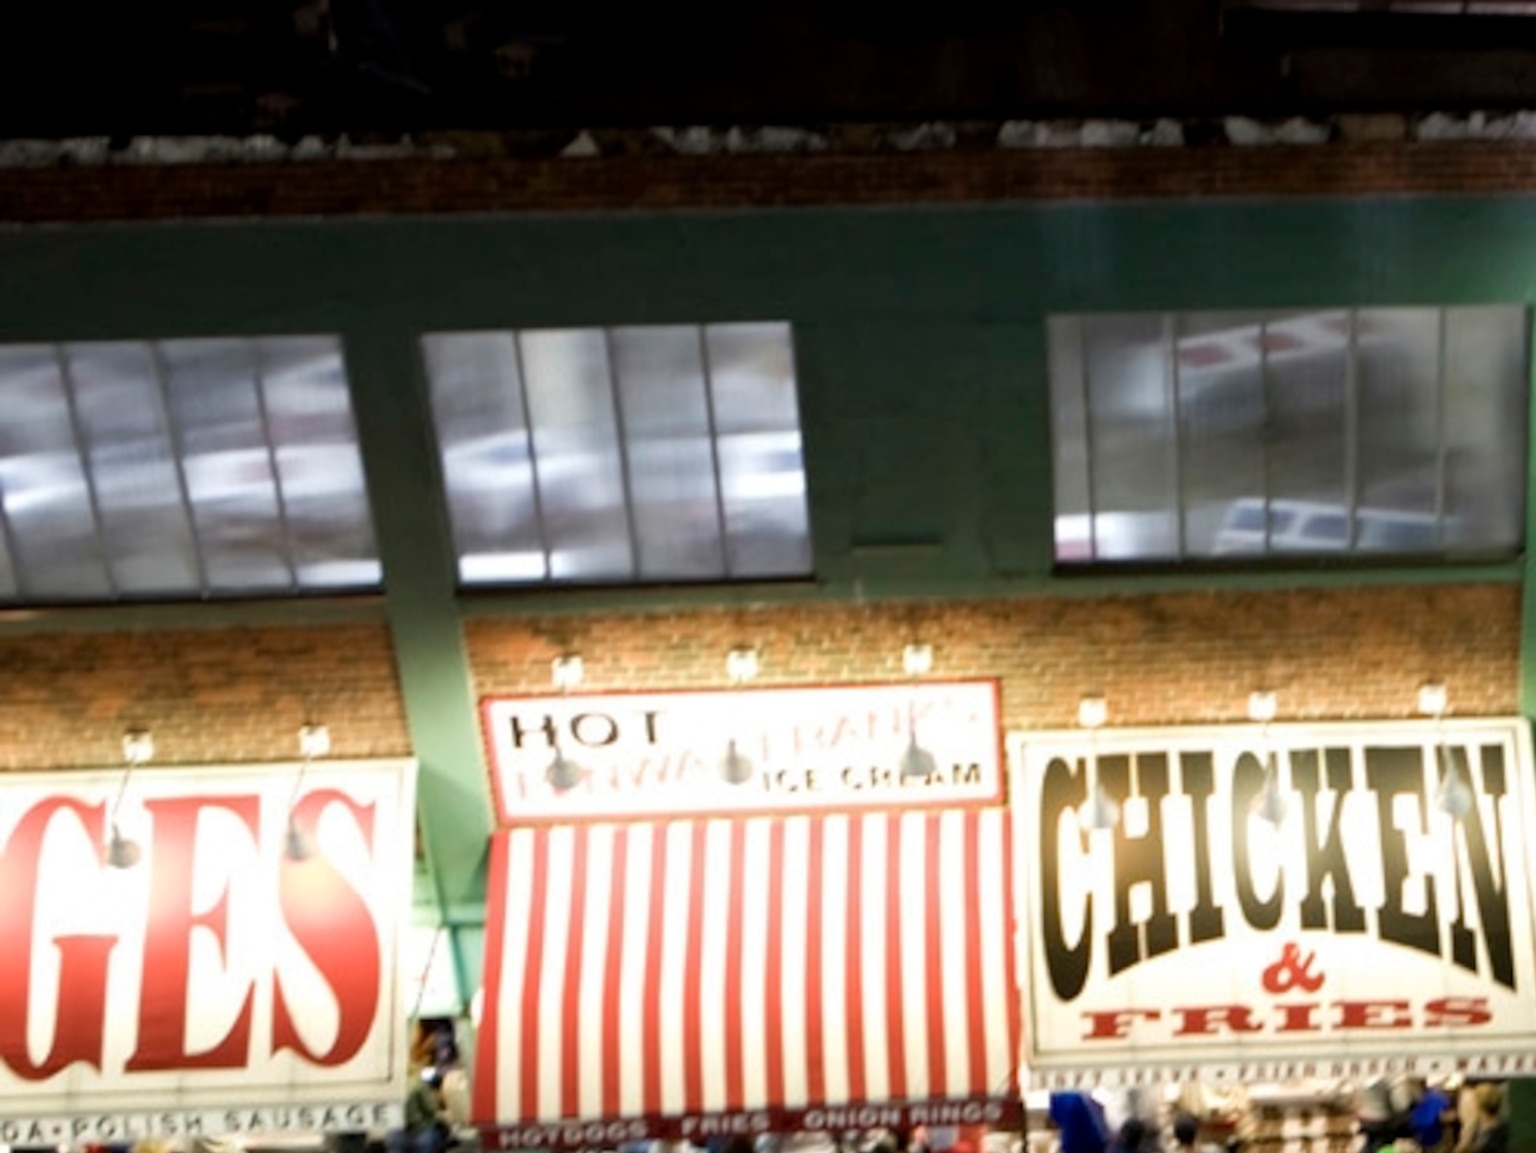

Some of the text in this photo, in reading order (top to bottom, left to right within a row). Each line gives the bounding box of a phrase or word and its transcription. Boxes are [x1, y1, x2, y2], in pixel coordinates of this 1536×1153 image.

[508, 709, 668, 749] HOT
[1039, 744, 1518, 1003] CHICKEN
[0, 787, 382, 1082] GES
[1261, 942, 1326, 995] &
[1080, 996, 1496, 1041] FRIES
[70, 1111, 202, 1143] POLISH
[223, 1103, 391, 1134] SAUSAGE
[681, 1111, 772, 1137] FRIES
[803, 1105, 899, 1130] ONION
[909, 1100, 1004, 1126] RINGS
